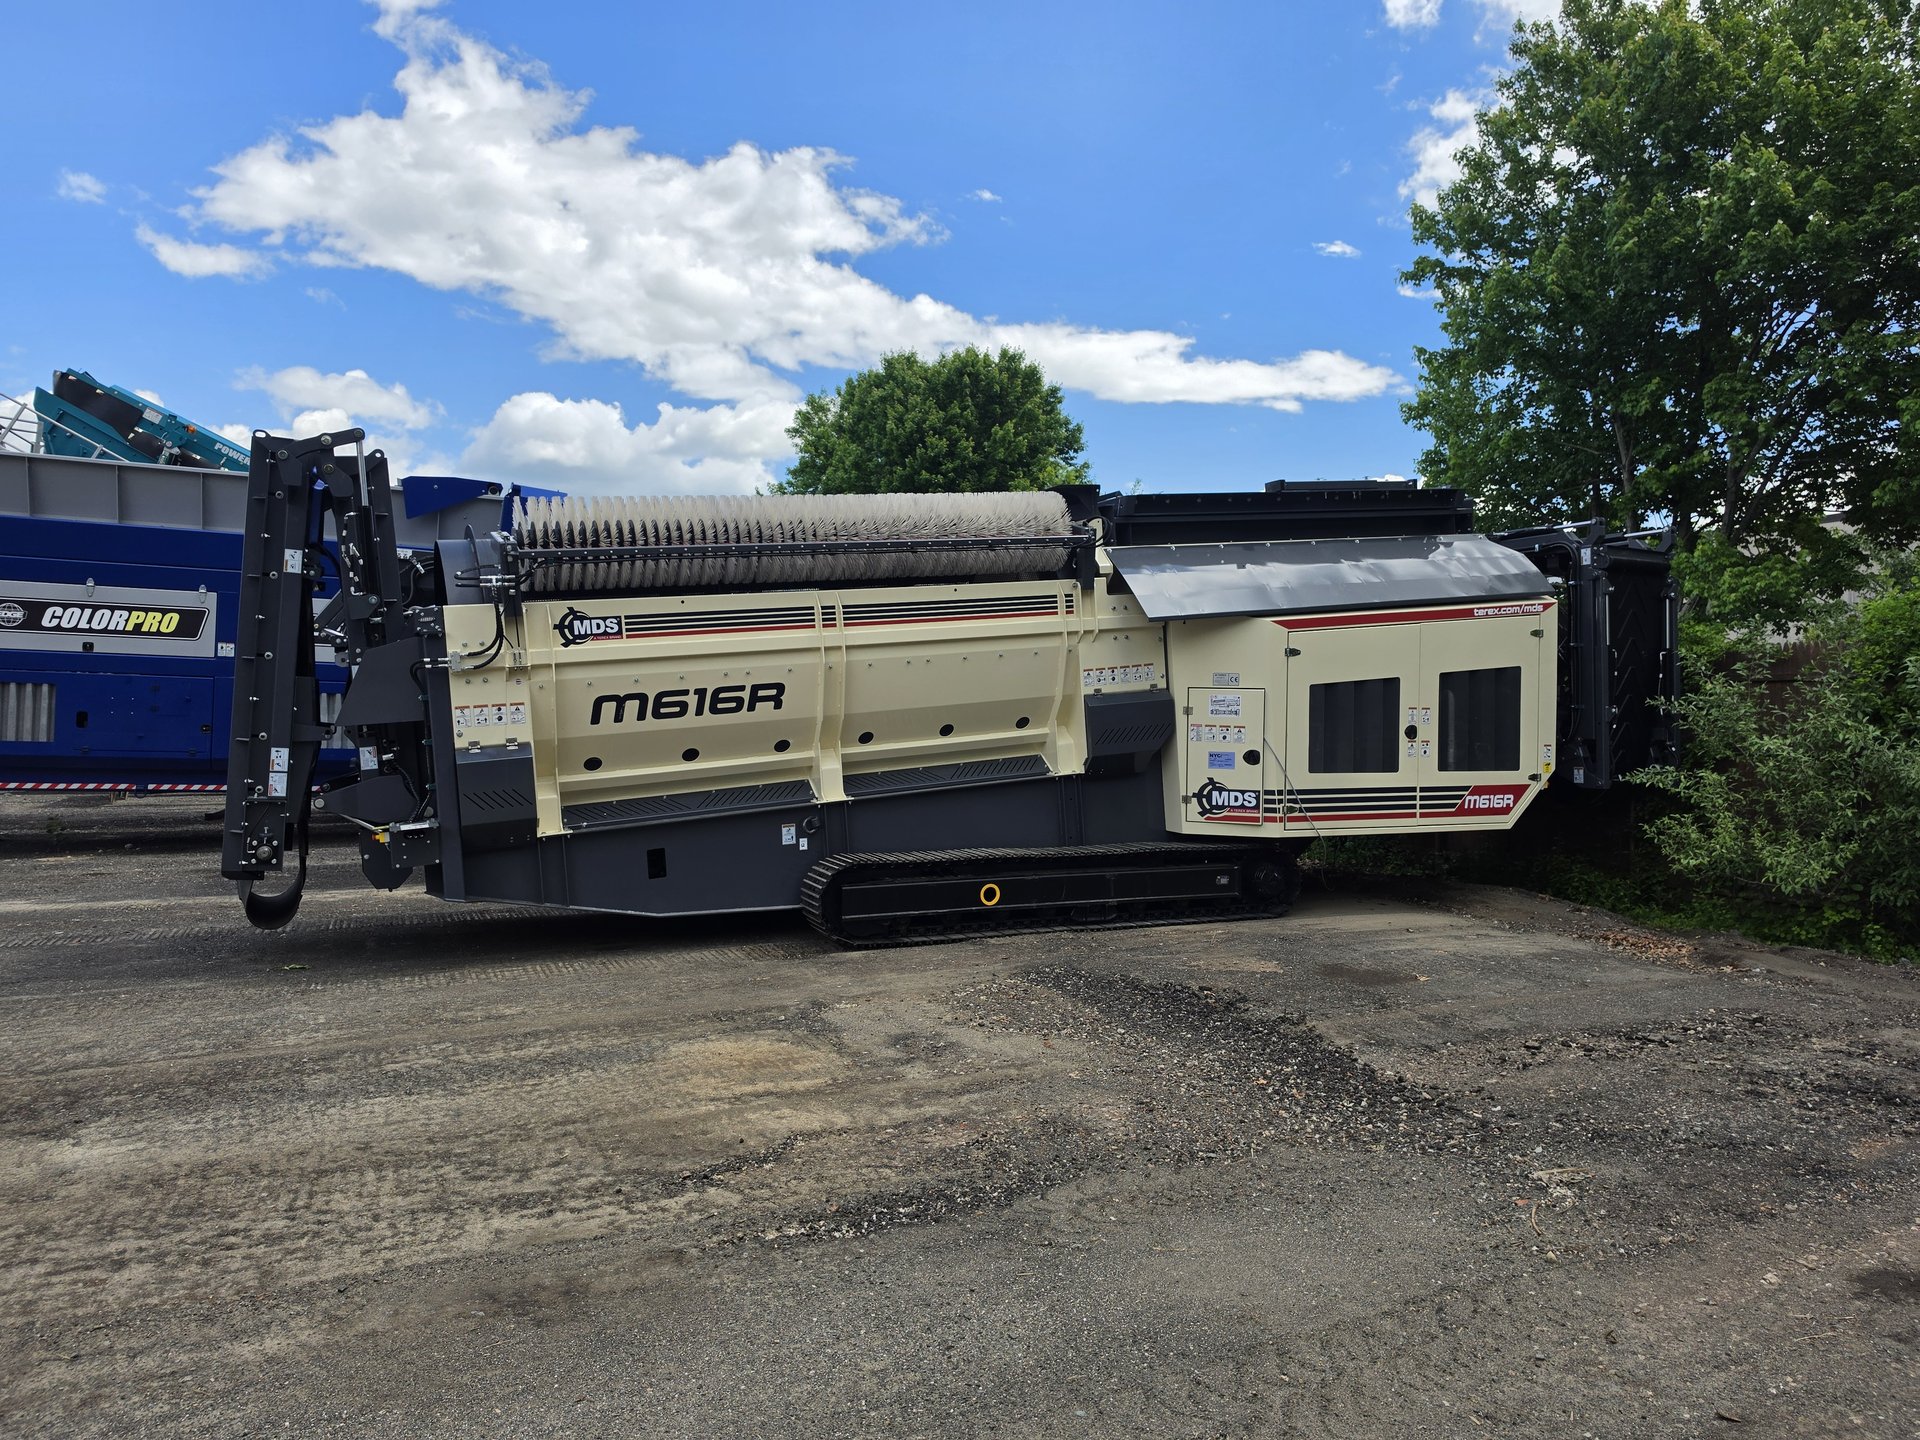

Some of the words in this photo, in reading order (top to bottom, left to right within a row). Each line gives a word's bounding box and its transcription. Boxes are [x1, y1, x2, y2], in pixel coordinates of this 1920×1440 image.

[1474, 603, 1544, 616] terex.com/mds
[41, 606, 180, 634] COLORPRO
[573, 617, 619, 635] MDS
[590, 682, 786, 726] M616R
[1212, 790, 1257, 807] MDS
[1464, 794, 1514, 809] M616R
